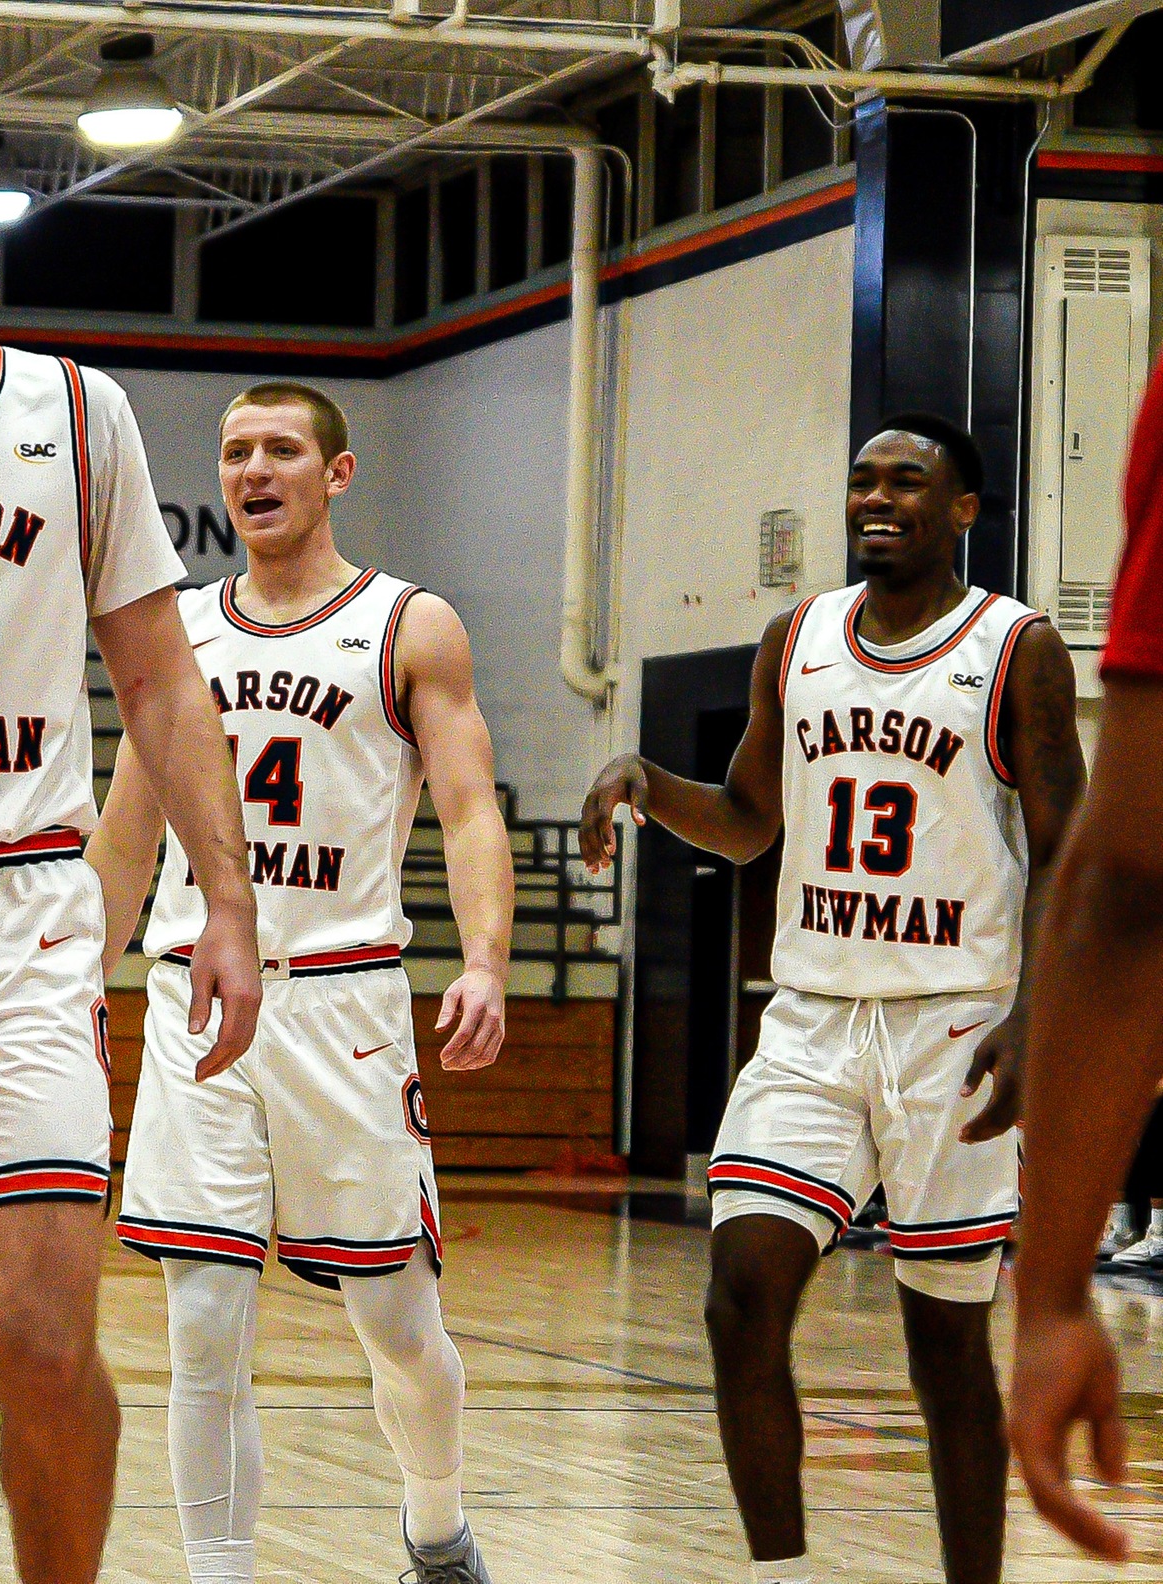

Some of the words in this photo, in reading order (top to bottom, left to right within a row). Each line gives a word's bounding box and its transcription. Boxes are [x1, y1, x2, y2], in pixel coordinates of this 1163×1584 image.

[19, 443, 57, 458] SAC
[340, 638, 371, 650] SAC
[210, 669, 355, 731] ARSON
[952, 673, 985, 689] SAC
[796, 707, 965, 778] CARSON
[825, 776, 919, 878] 13
[800, 882, 966, 947] NEWMAN
